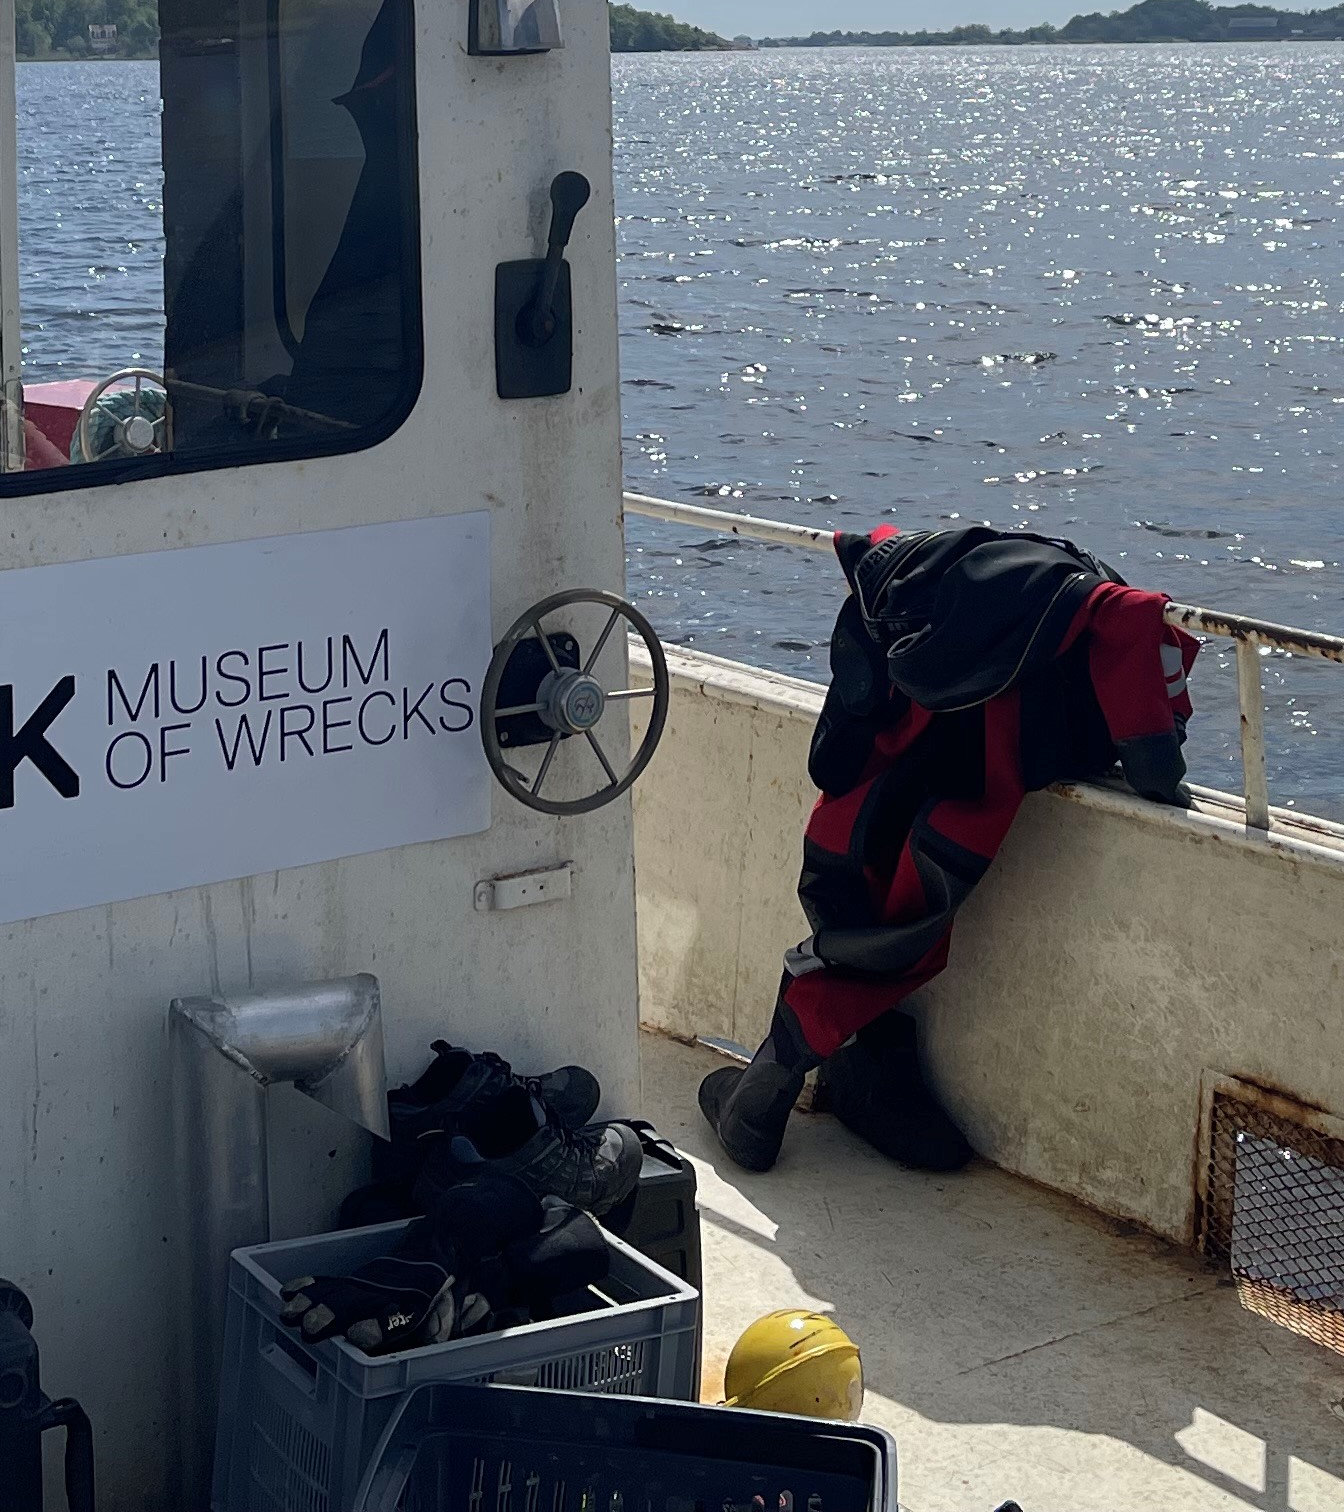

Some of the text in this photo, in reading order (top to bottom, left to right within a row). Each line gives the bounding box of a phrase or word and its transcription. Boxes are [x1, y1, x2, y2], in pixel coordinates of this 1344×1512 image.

[107, 628, 389, 726] MUSEUM
[105, 678, 474, 790] OF WRECKS
